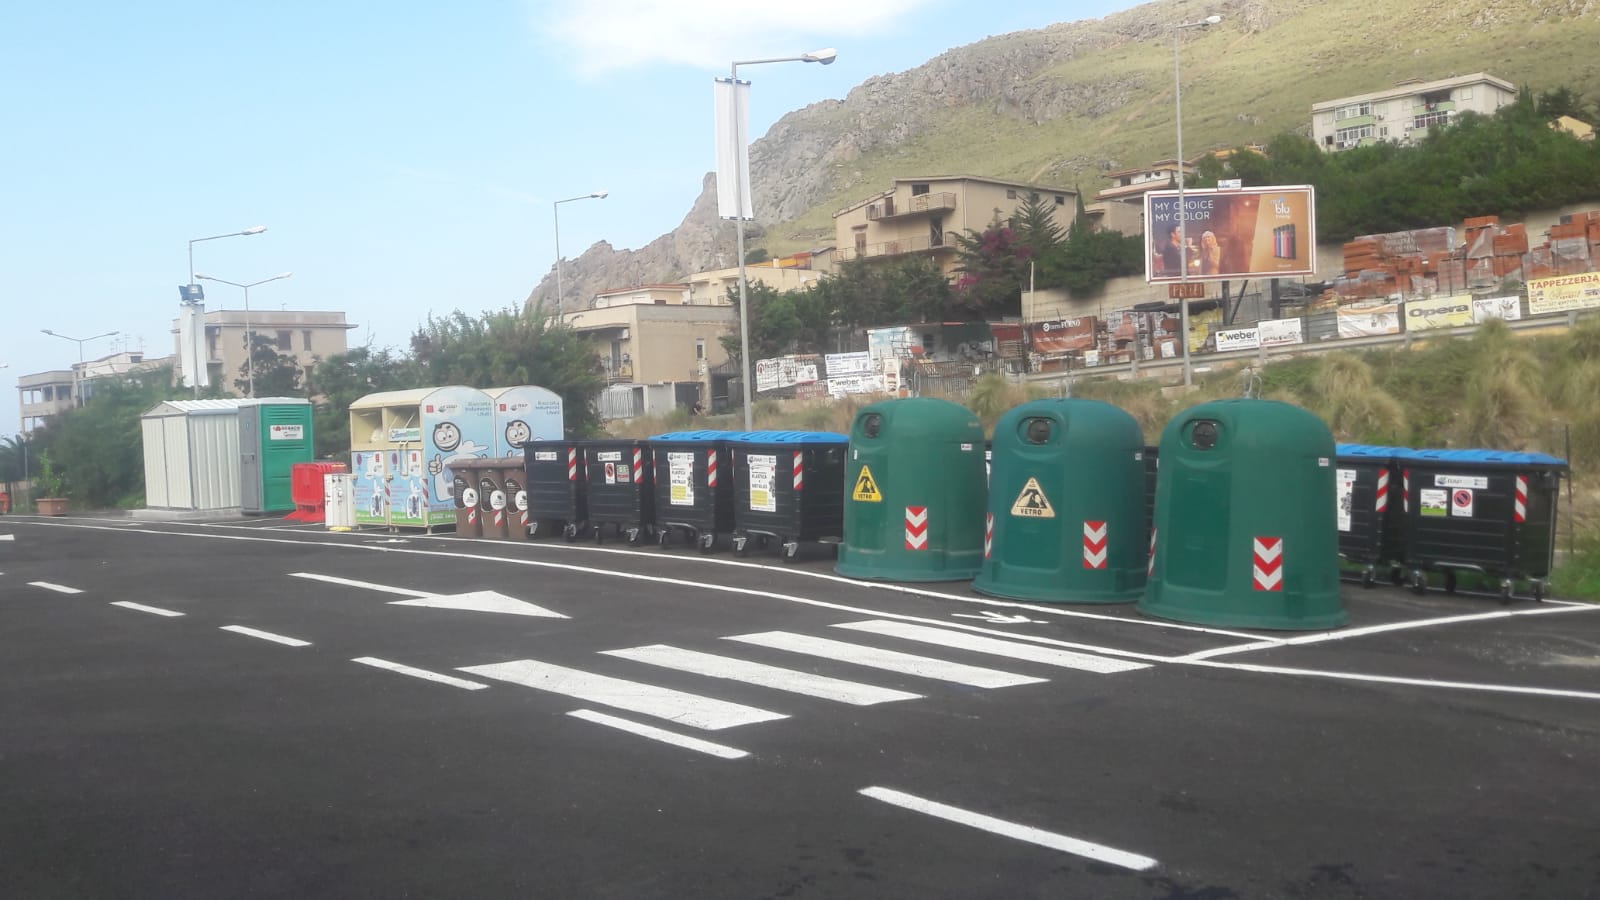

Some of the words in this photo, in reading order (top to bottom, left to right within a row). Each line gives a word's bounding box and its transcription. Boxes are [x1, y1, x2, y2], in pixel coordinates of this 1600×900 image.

[1154, 202, 1170, 211] MY
[1173, 200, 1214, 210] CHOICE
[1275, 202, 1290, 214] blu
[1155, 213, 1170, 222] MY
[1173, 211, 1210, 221] COLOR
[1530, 274, 1600, 289] TAPPEZZERIA
[1409, 305, 1468, 318] Opera
[1226, 331, 1256, 340] weber
[836, 378, 860, 386] weber
[1020, 508, 1042, 516] VETRO
